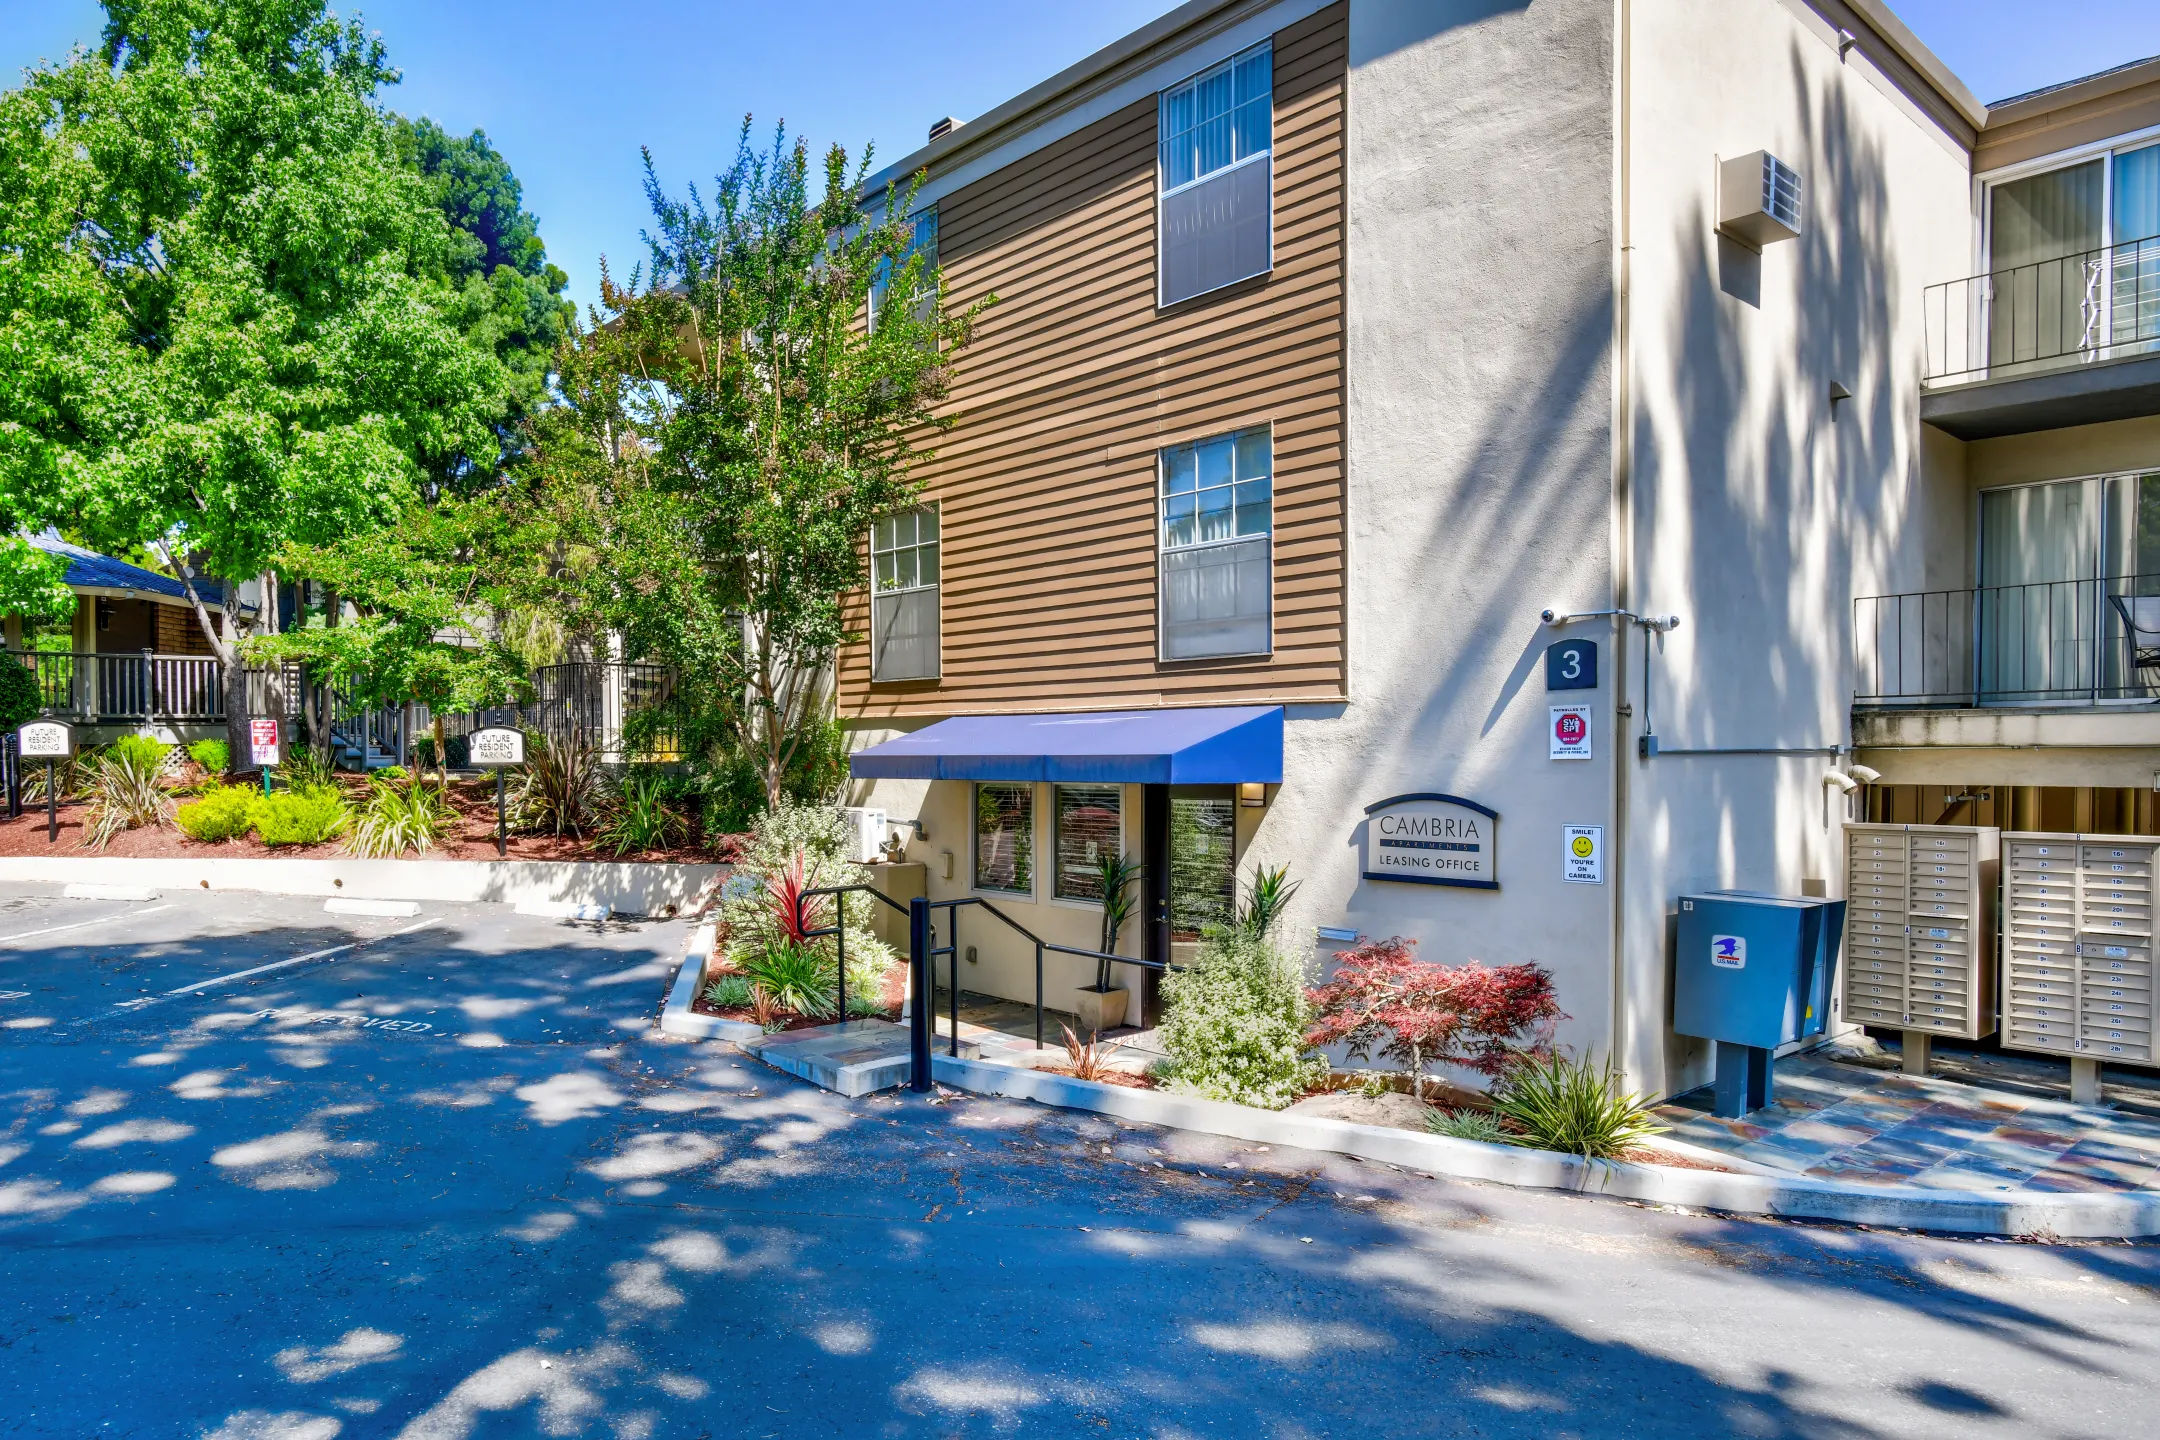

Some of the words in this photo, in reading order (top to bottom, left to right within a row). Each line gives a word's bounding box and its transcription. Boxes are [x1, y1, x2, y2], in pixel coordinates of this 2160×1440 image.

[1562, 650, 1580, 679] 3
[31, 728, 57, 736] FUTURE
[482, 734, 510, 742] FUTURE
[479, 743, 514, 751] RESIDENT
[480, 751, 513, 759] PARKING
[1380, 815, 1479, 838] CAMBRIA
[1391, 840, 1468, 850] APARTMENTS
[1379, 855, 1430, 868] LEASING
[1436, 859, 1479, 871] OFFICE
[2077, 945, 2080, 953] B
